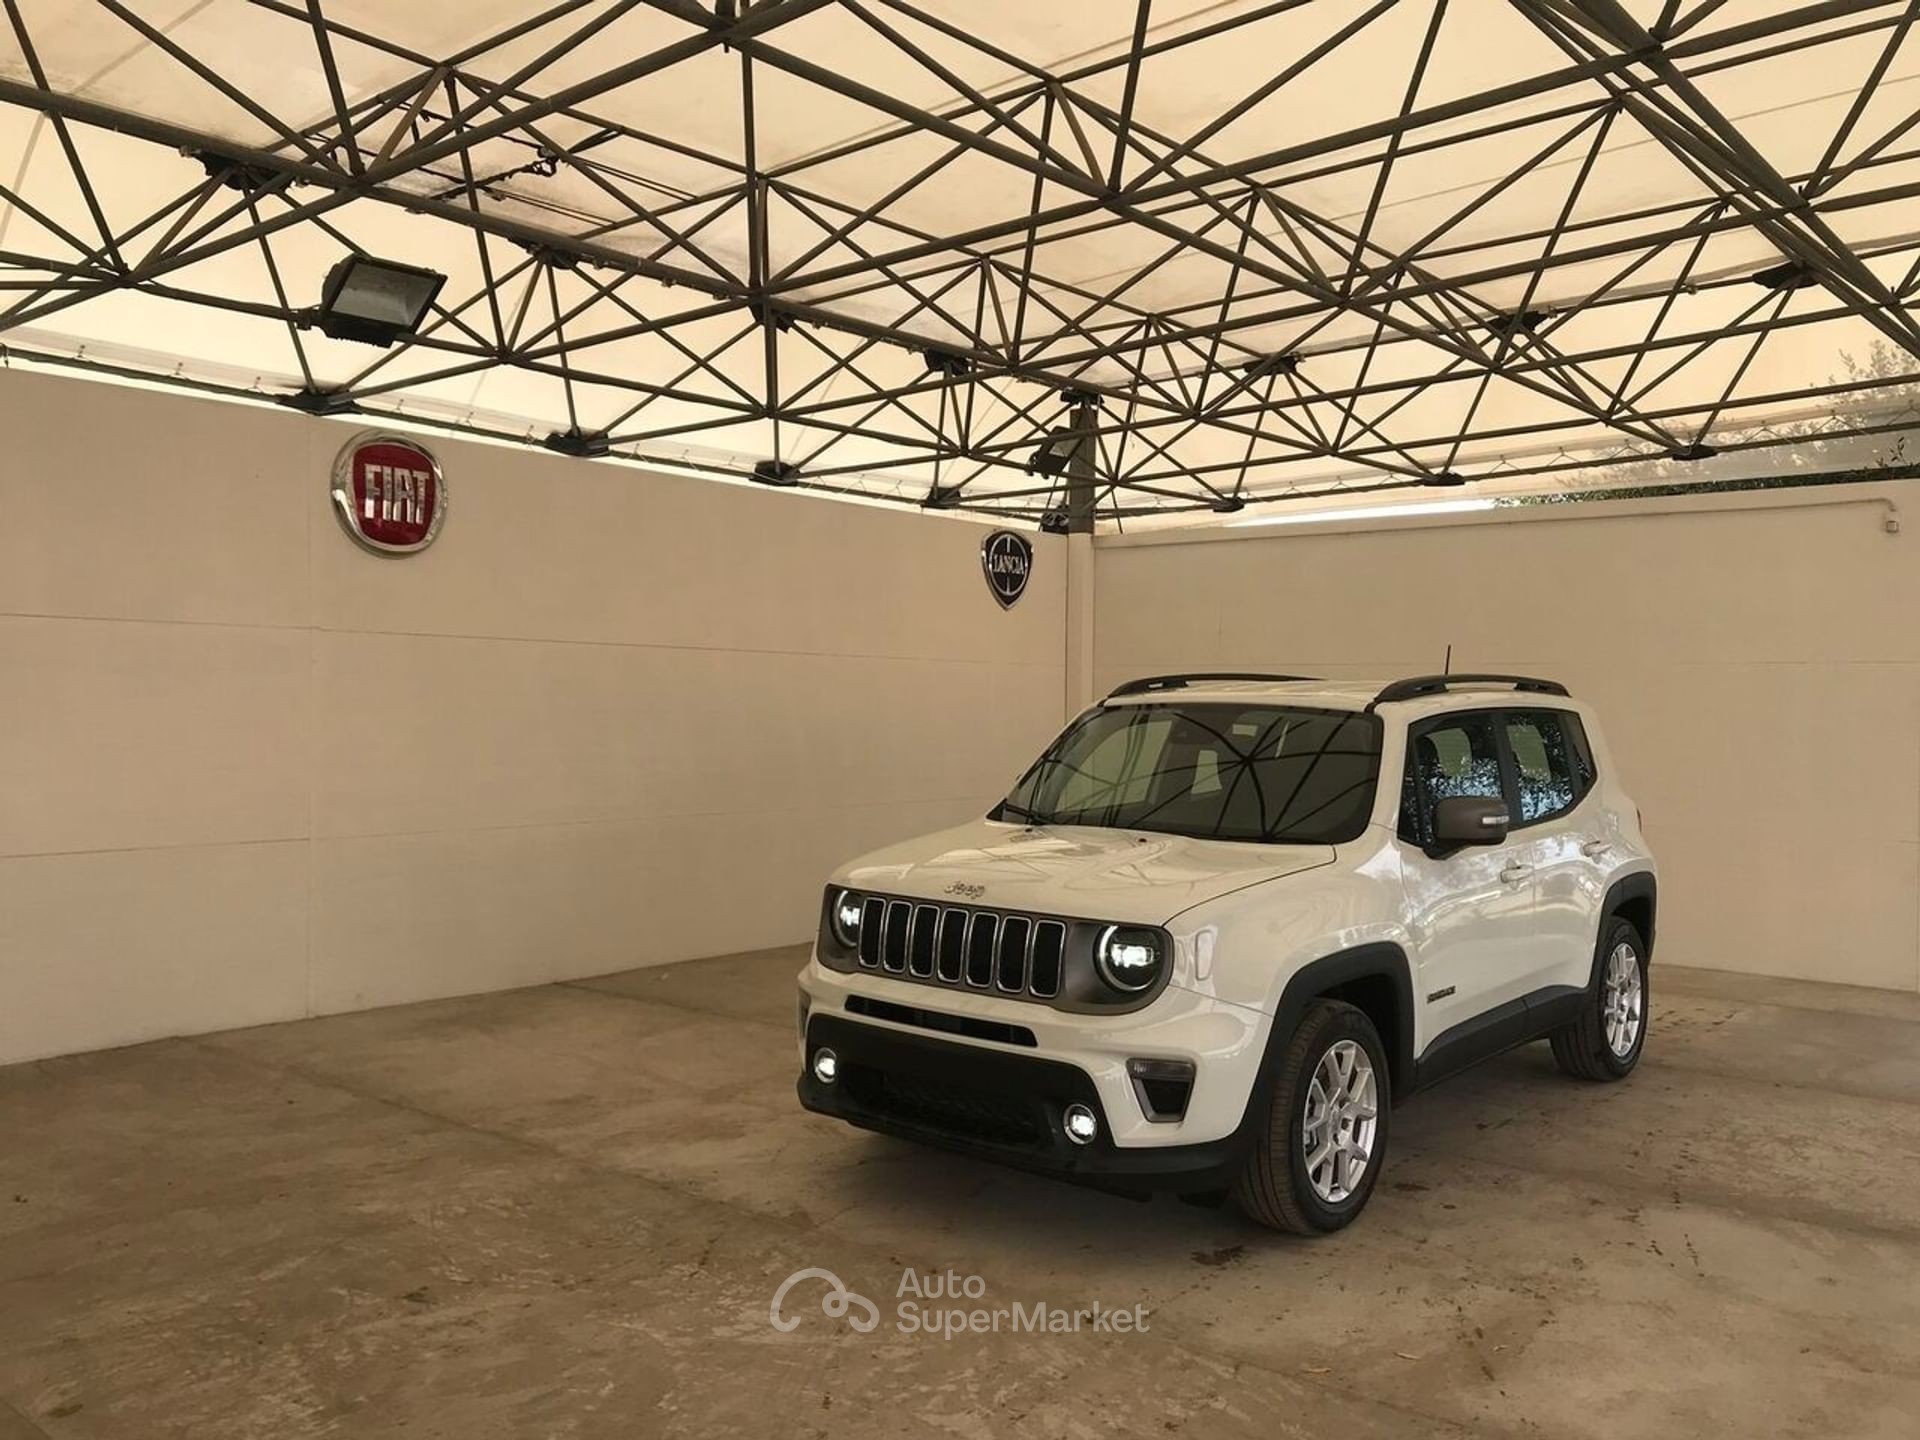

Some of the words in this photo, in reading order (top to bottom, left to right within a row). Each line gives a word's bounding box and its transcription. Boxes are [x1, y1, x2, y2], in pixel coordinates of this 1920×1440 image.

[364, 463, 430, 525] FIAT
[993, 554, 1025, 575] LANCIA
[944, 881, 985, 900] Jeep
